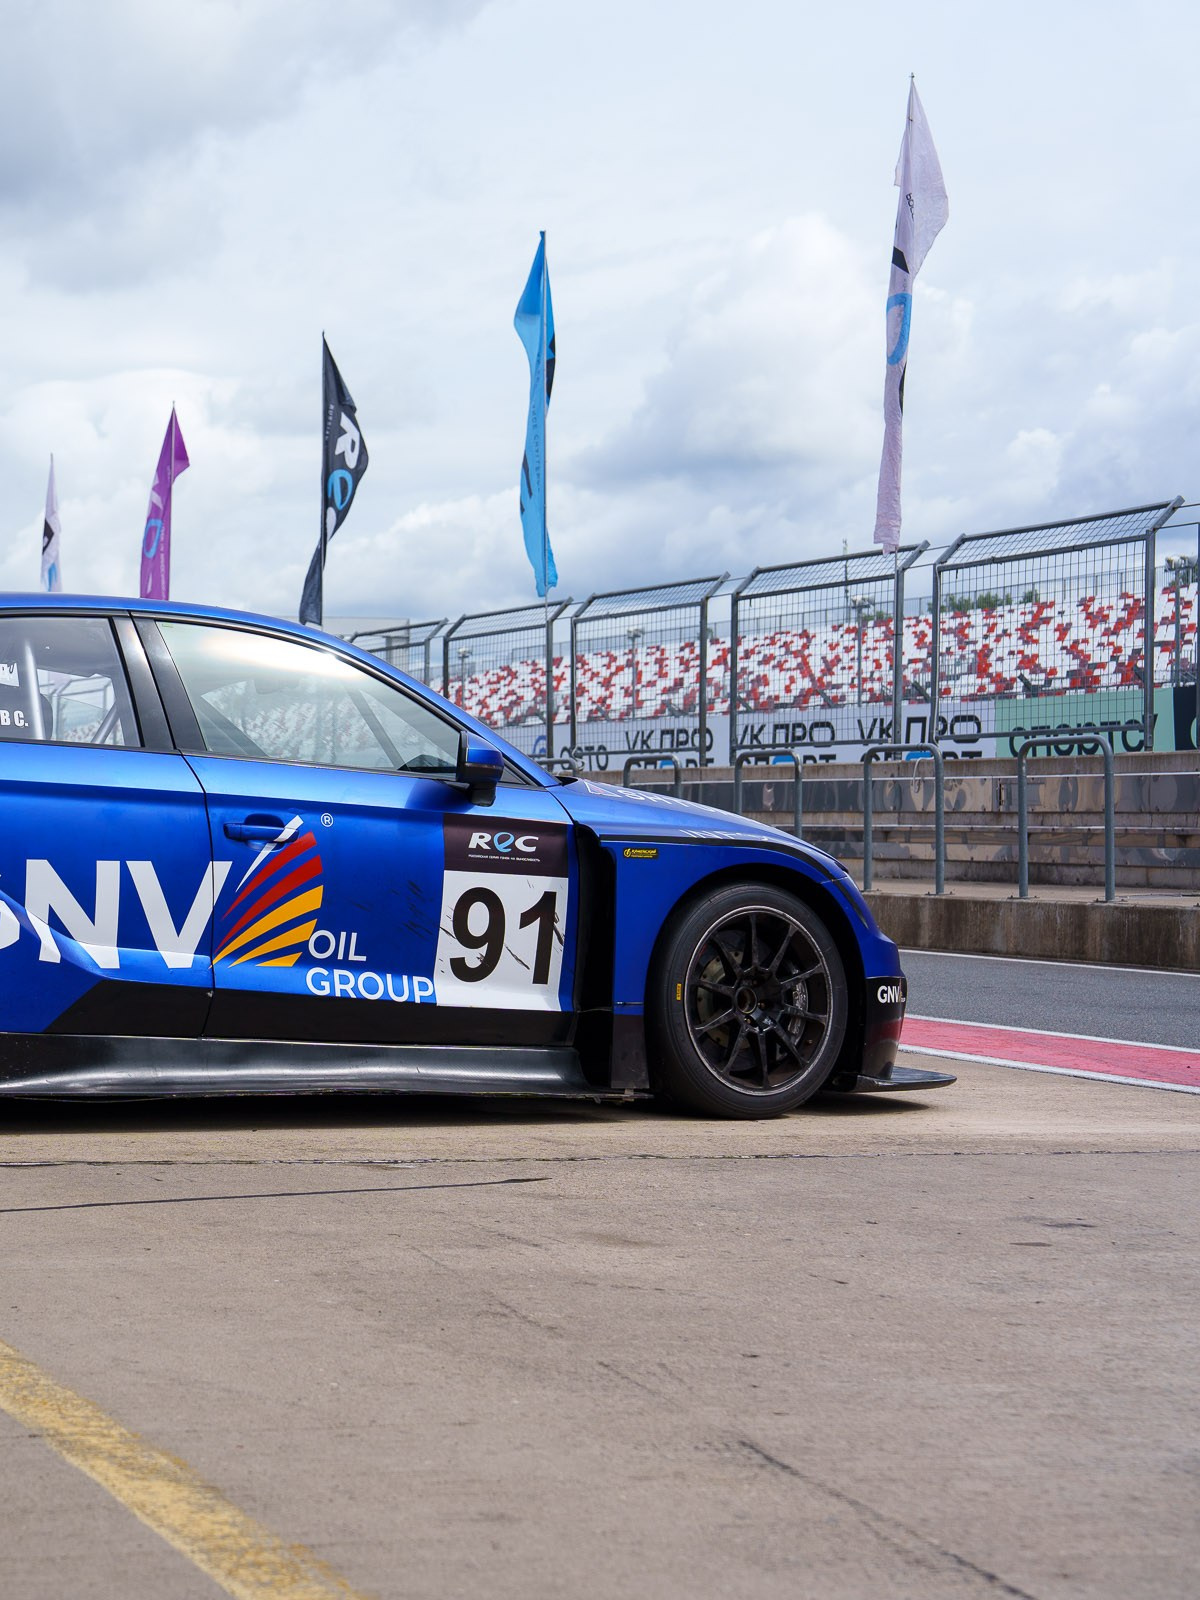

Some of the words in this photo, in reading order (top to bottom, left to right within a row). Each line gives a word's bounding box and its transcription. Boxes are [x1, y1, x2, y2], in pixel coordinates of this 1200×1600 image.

[14, 710, 29, 727] С.
[772, 721, 836, 749] ПРО
[308, 929, 367, 962] OIL
[449, 886, 557, 985] 91
[306, 966, 434, 1004] GROUP
[877, 985, 900, 1003] GNV
